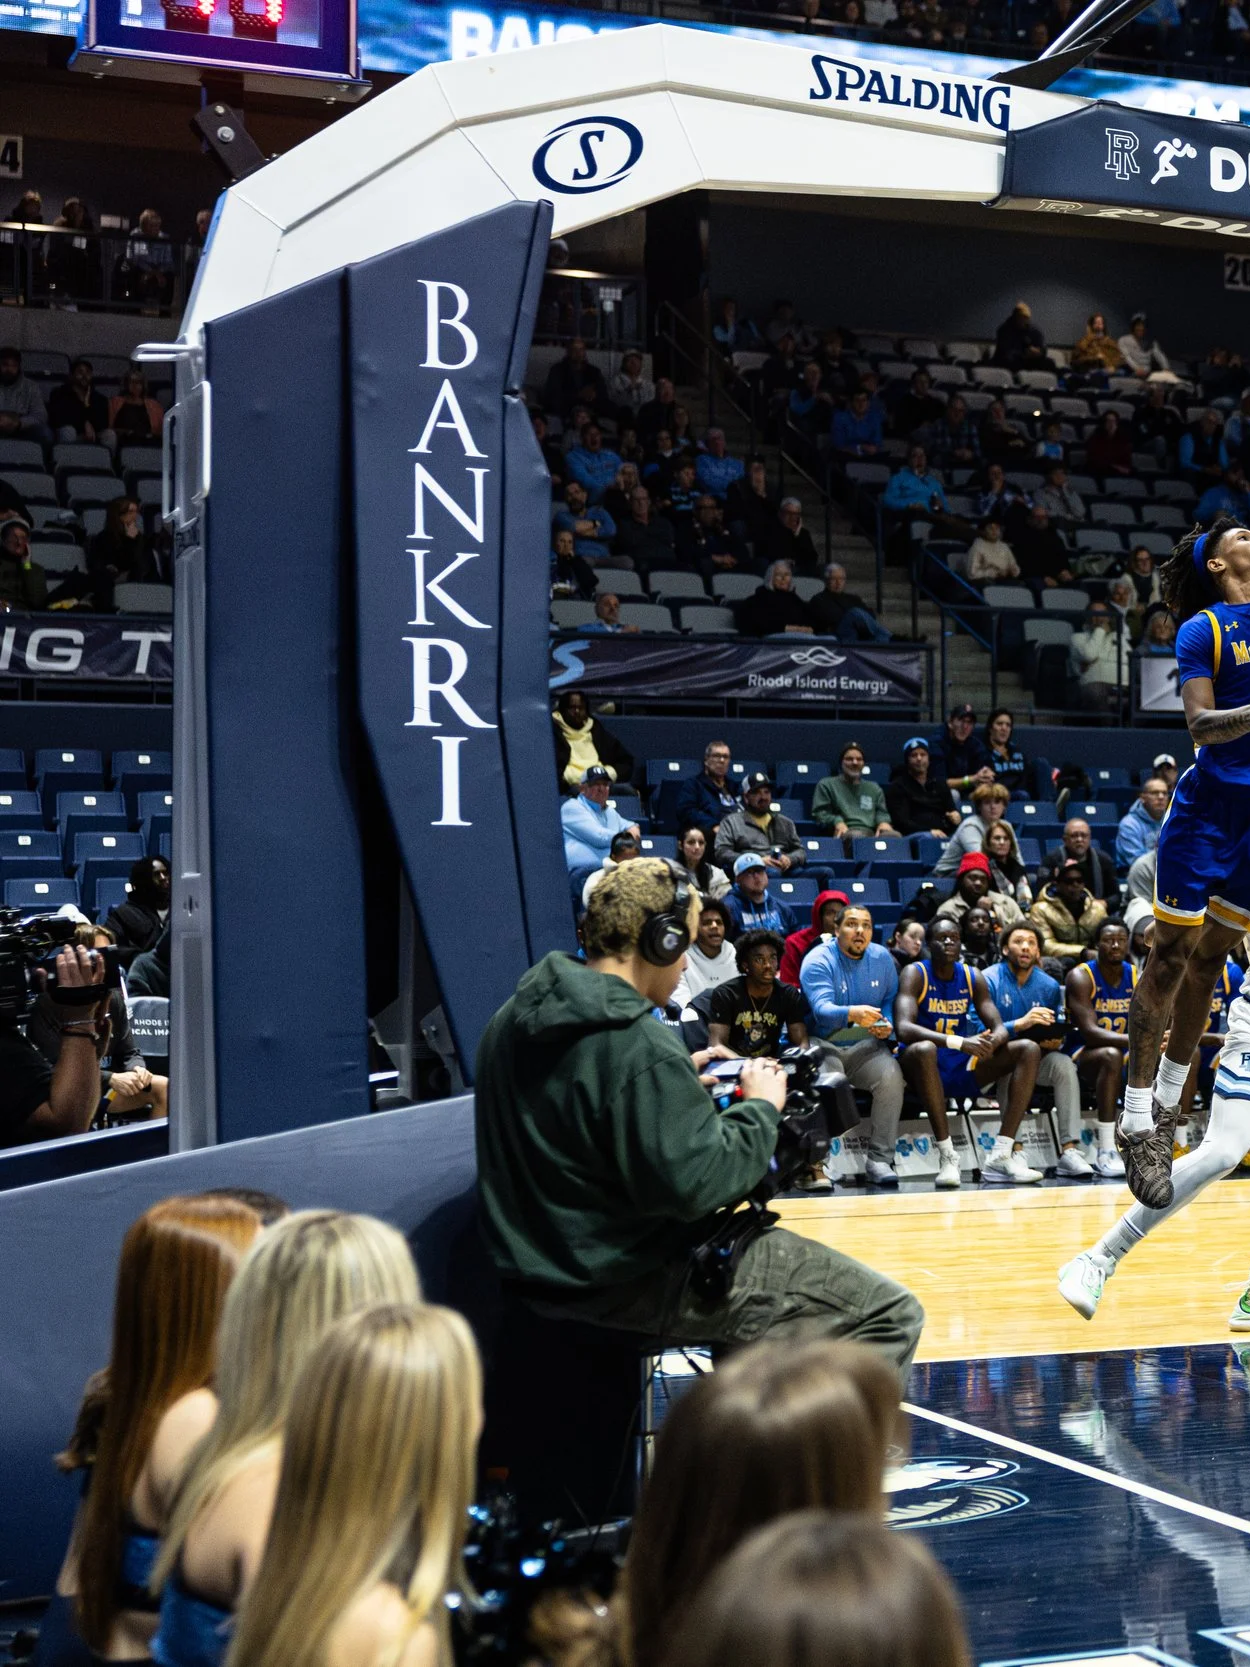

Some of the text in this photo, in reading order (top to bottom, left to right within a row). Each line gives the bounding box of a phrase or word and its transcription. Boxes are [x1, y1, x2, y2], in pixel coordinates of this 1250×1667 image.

[810, 54, 1011, 132] SPALDING
[402, 280, 498, 827] BANKRI
[748, 674, 891, 694] Rhode Island Energy
[928, 997, 968, 1016] McNEESE
[935, 1017, 960, 1037] 15
